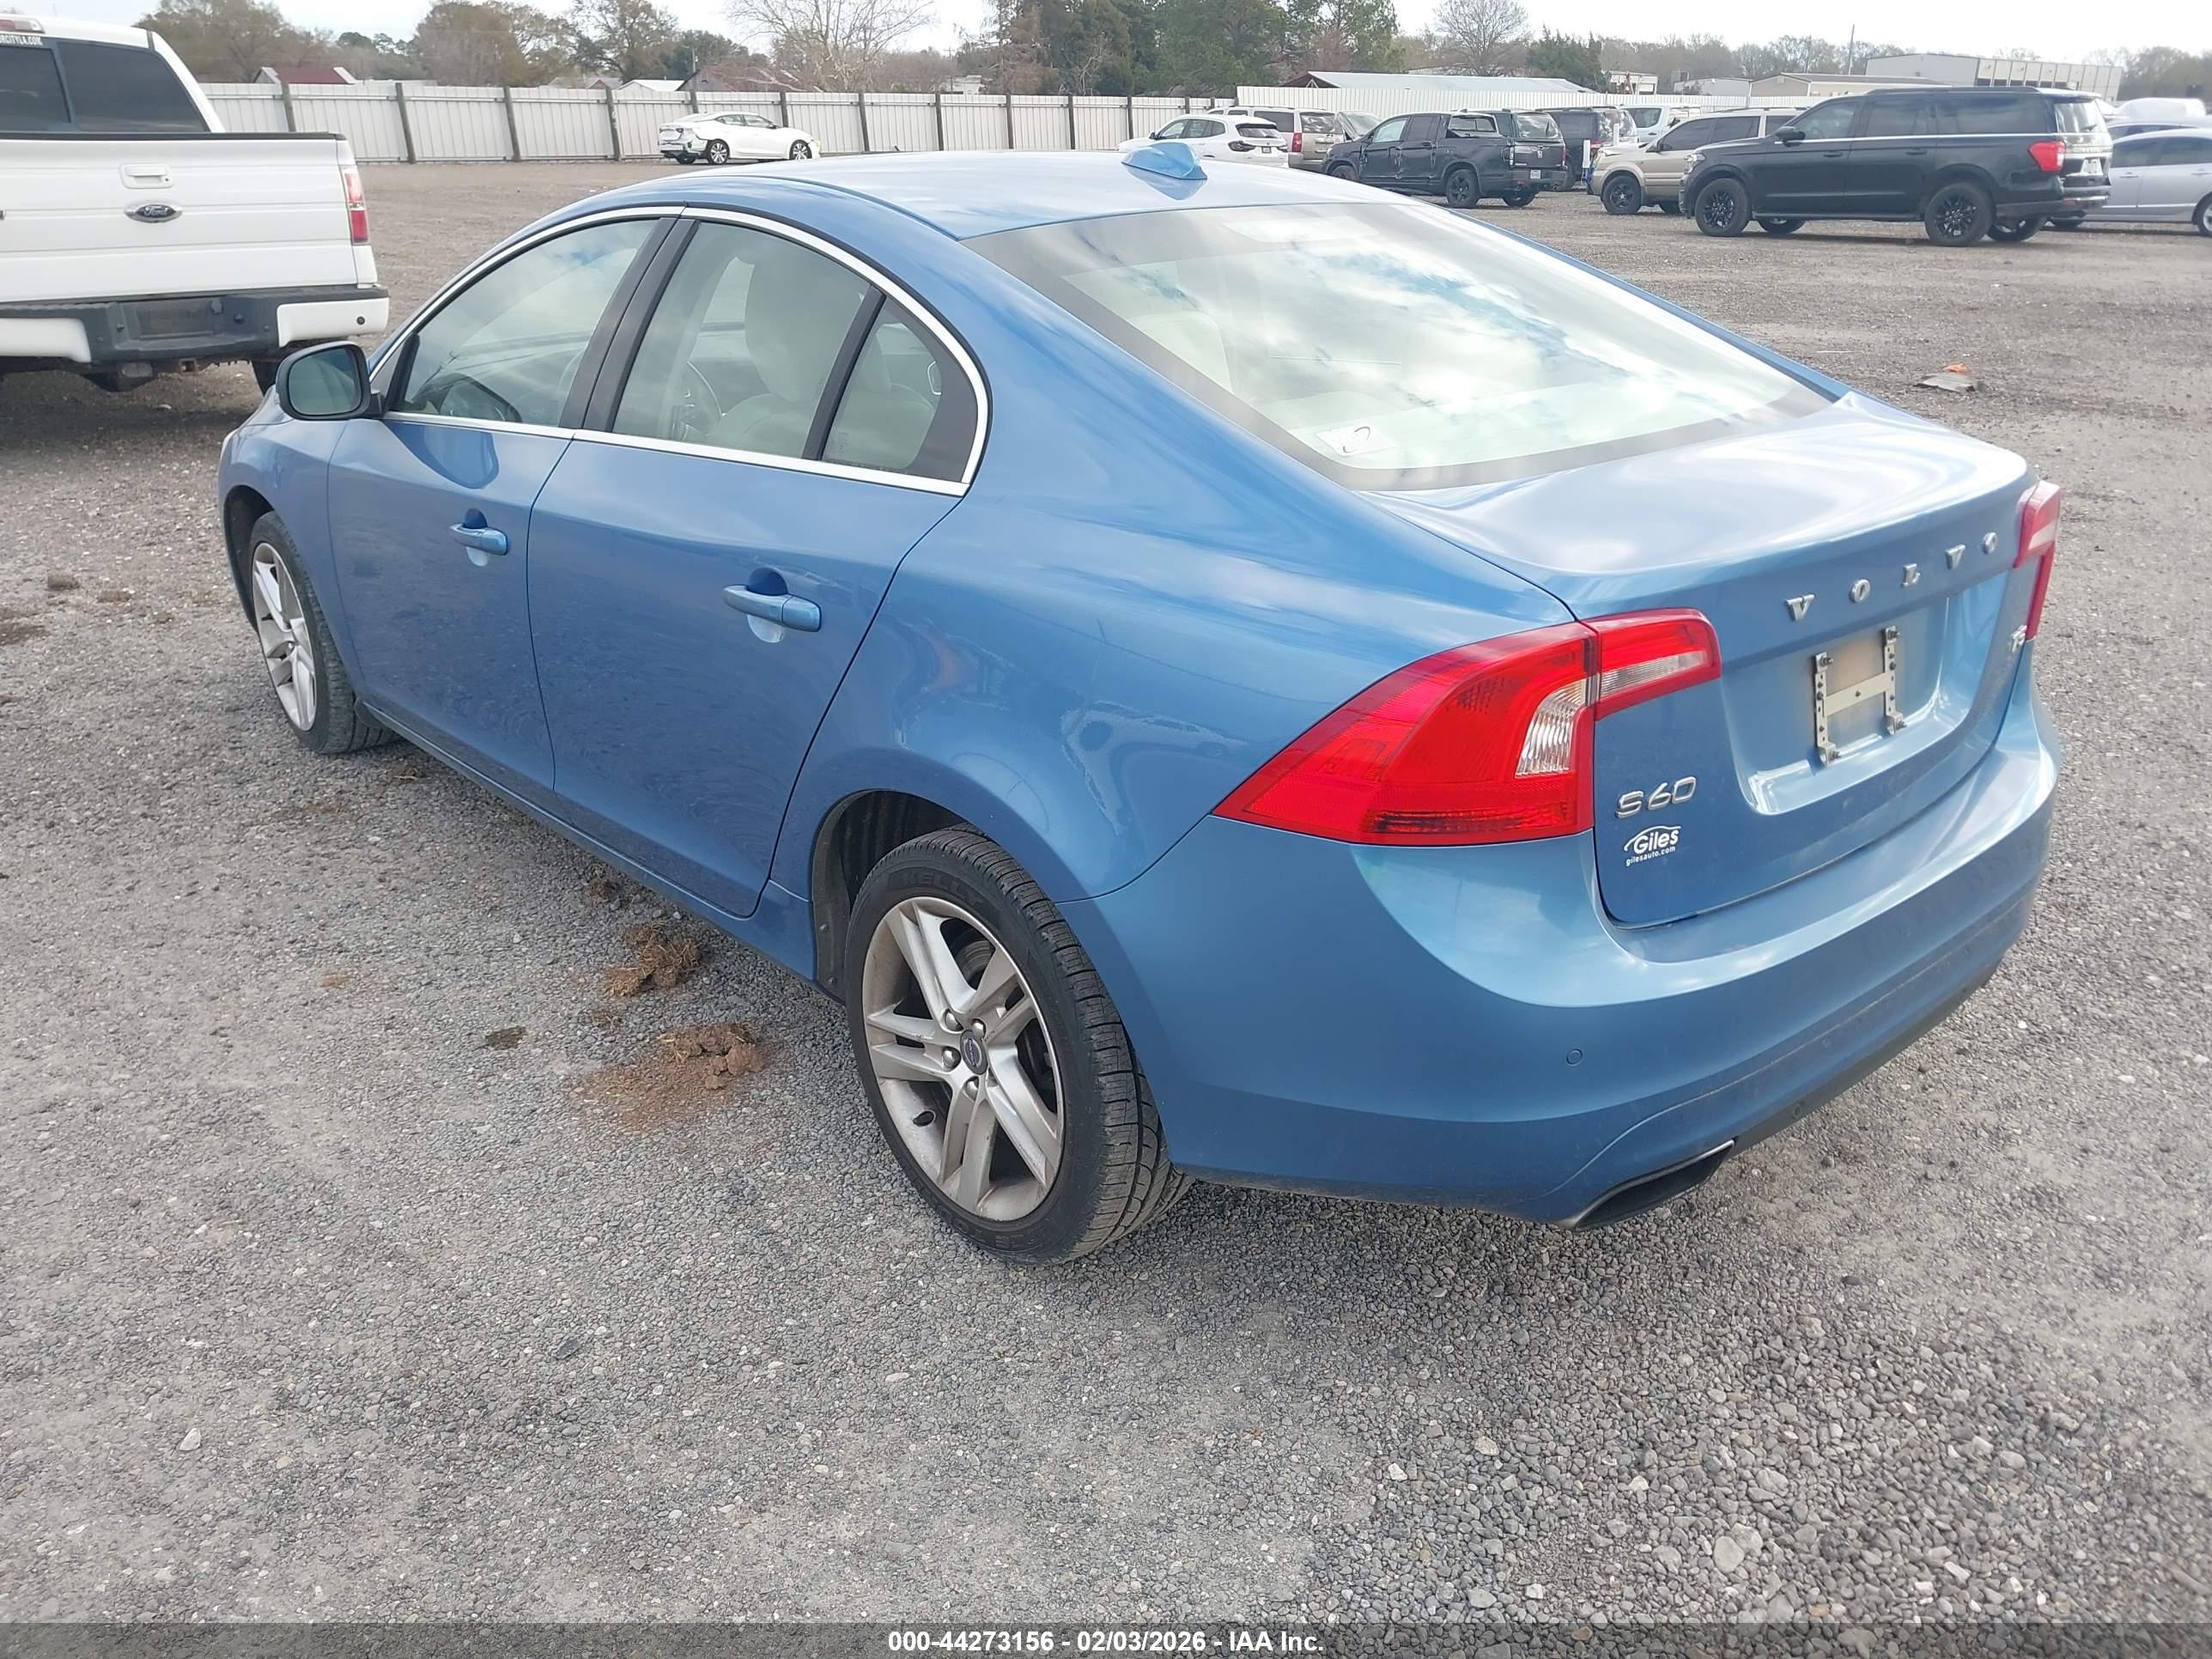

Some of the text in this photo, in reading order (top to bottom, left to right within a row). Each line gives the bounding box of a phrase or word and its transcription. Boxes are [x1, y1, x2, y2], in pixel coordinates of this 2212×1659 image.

[1785, 531, 1999, 621] VOLVO
[1614, 776, 1697, 818] S60
[1626, 846, 1676, 866] gilesauto.com
[1633, 830, 1680, 854] Giles
